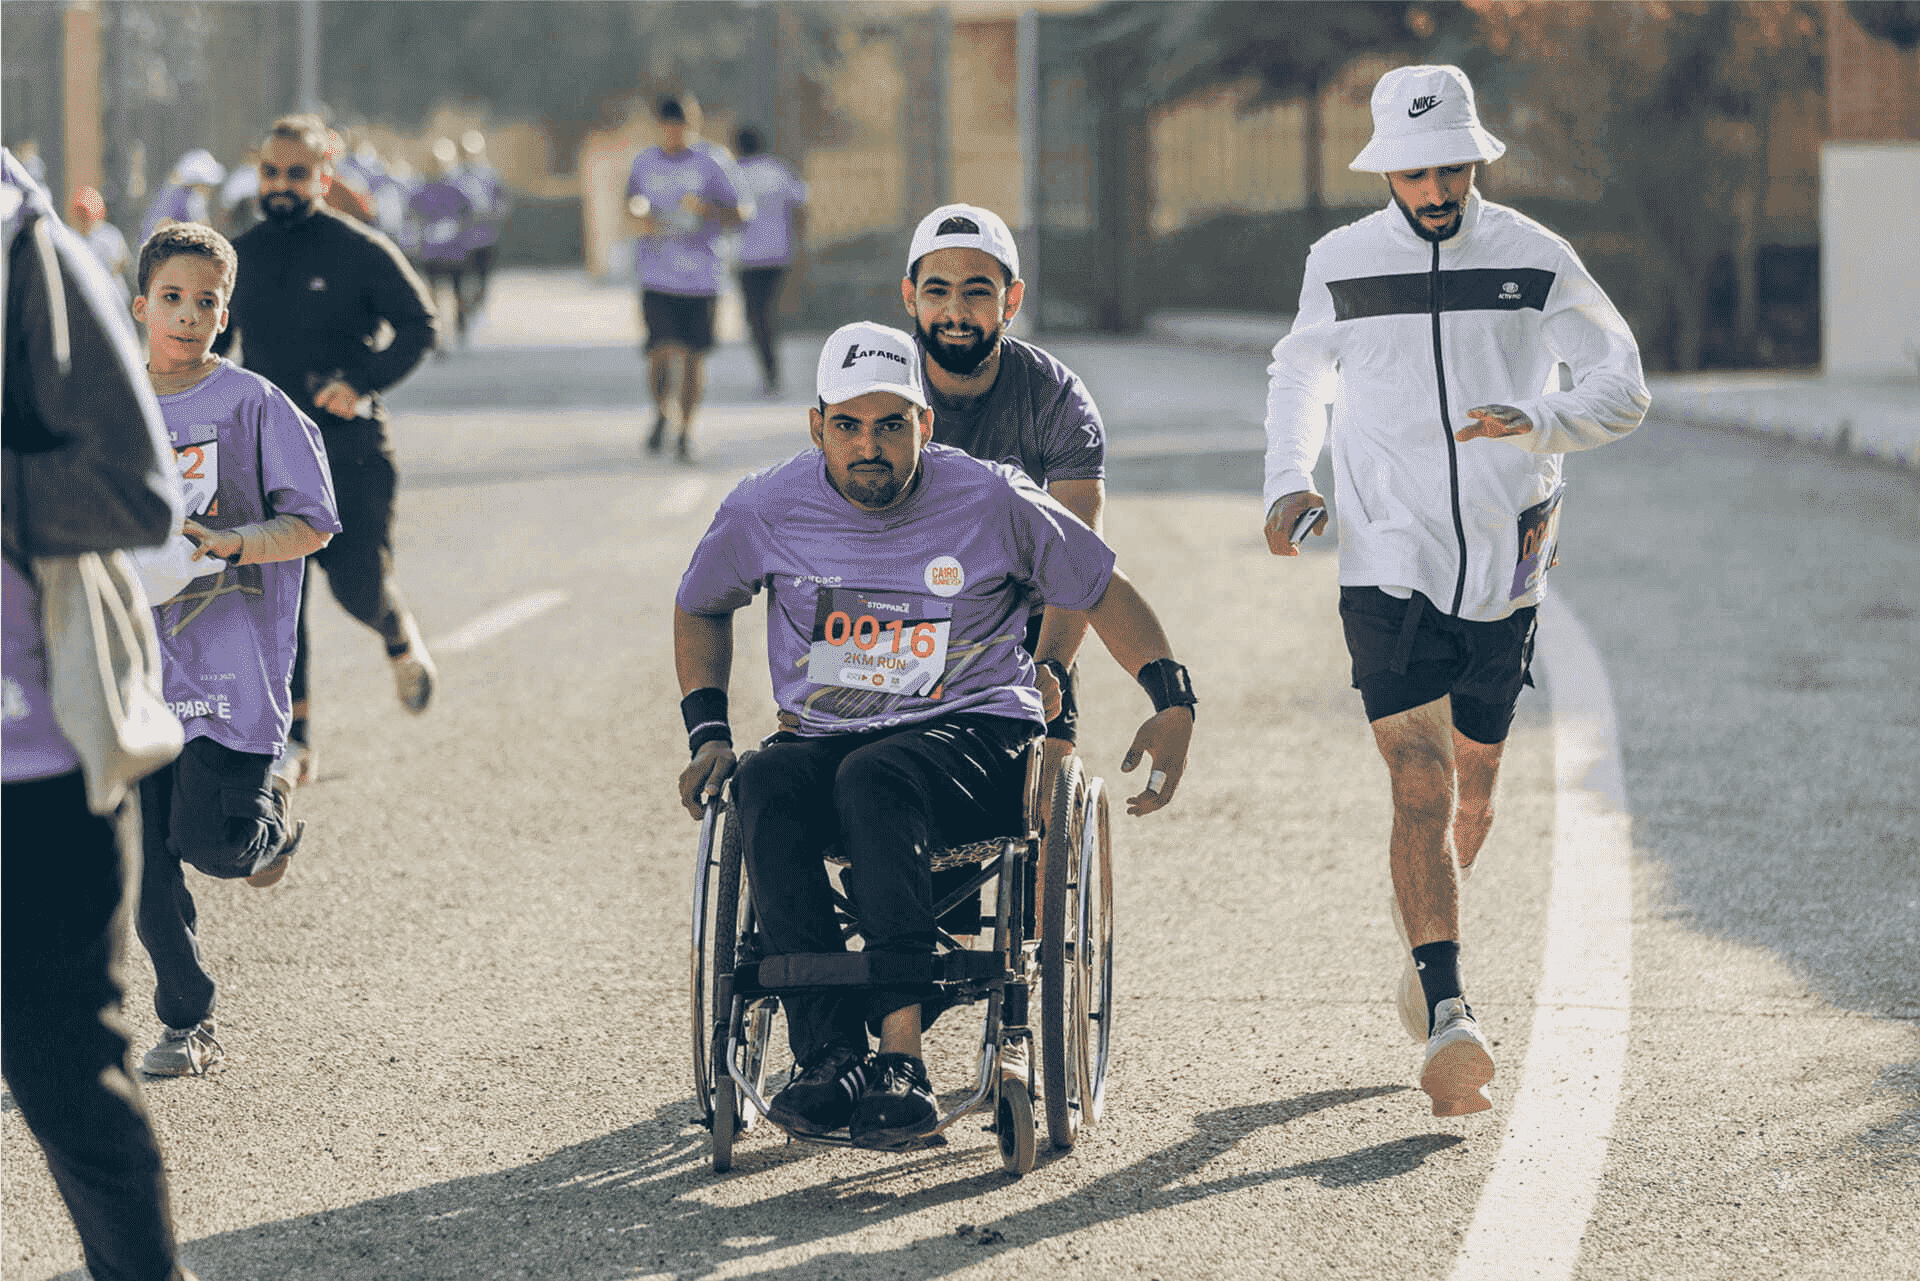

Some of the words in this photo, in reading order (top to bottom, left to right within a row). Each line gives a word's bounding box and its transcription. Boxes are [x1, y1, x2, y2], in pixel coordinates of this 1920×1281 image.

[1412, 95, 1437, 111] NIKE
[841, 343, 907, 369] LAFARGE
[172, 446, 205, 480] 2
[931, 566, 959, 579] CAIRO
[825, 610, 937, 659] 0016
[844, 651, 874, 666] 2KM
[877, 656, 907, 670] RUN
